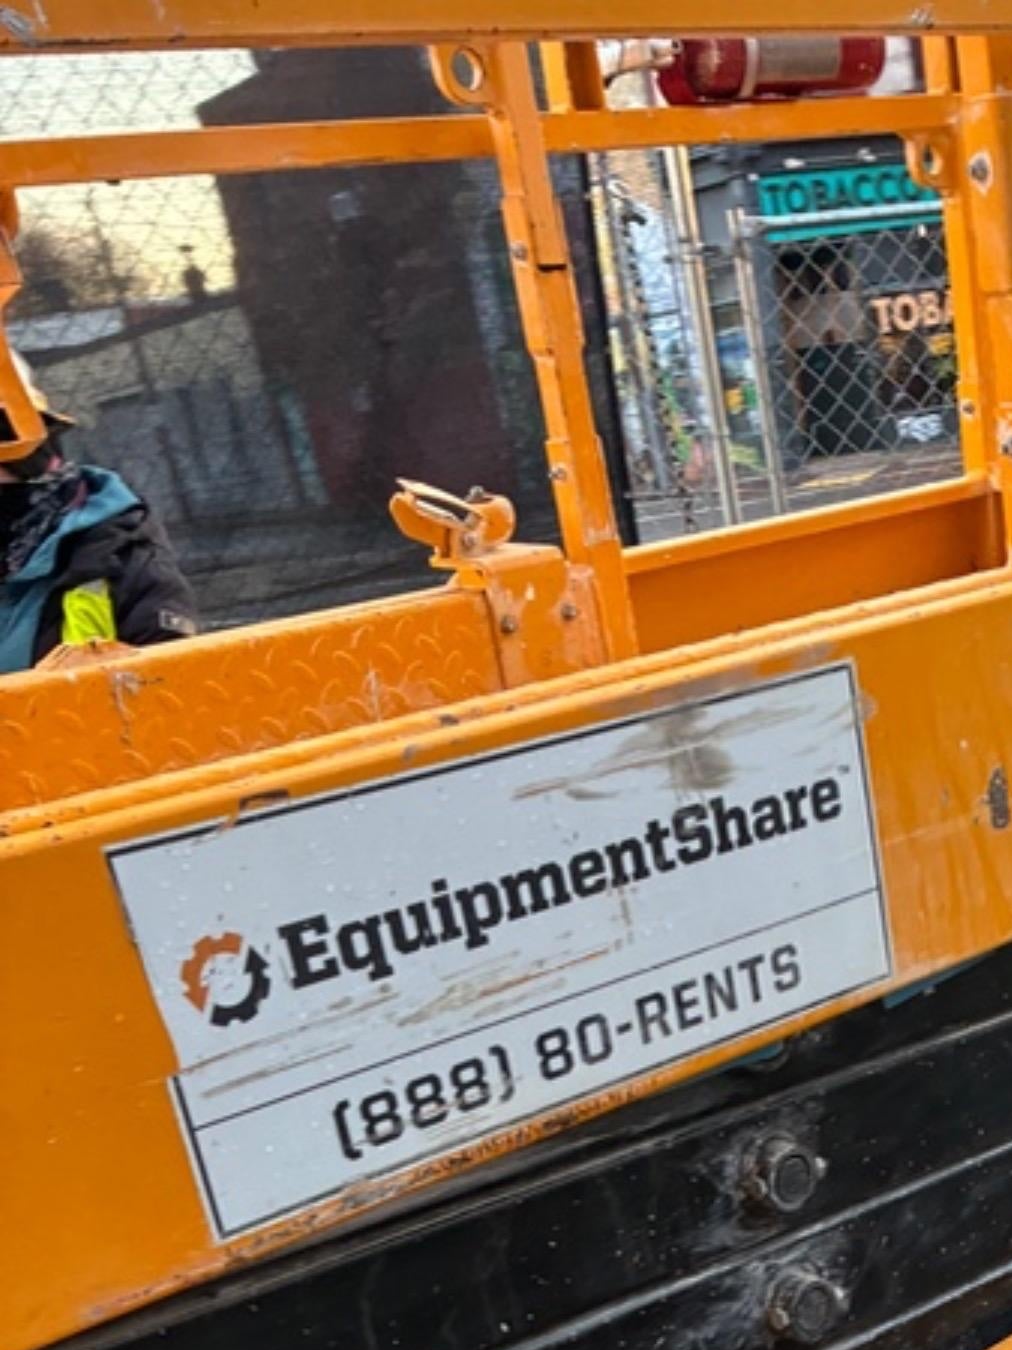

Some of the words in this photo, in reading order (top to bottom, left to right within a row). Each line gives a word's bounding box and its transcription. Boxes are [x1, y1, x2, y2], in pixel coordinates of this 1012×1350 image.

[278, 776, 842, 988] EquipmentShare
[333, 1045, 515, 1160] (888)
[535, 945, 801, 1081] 80-RENTS
